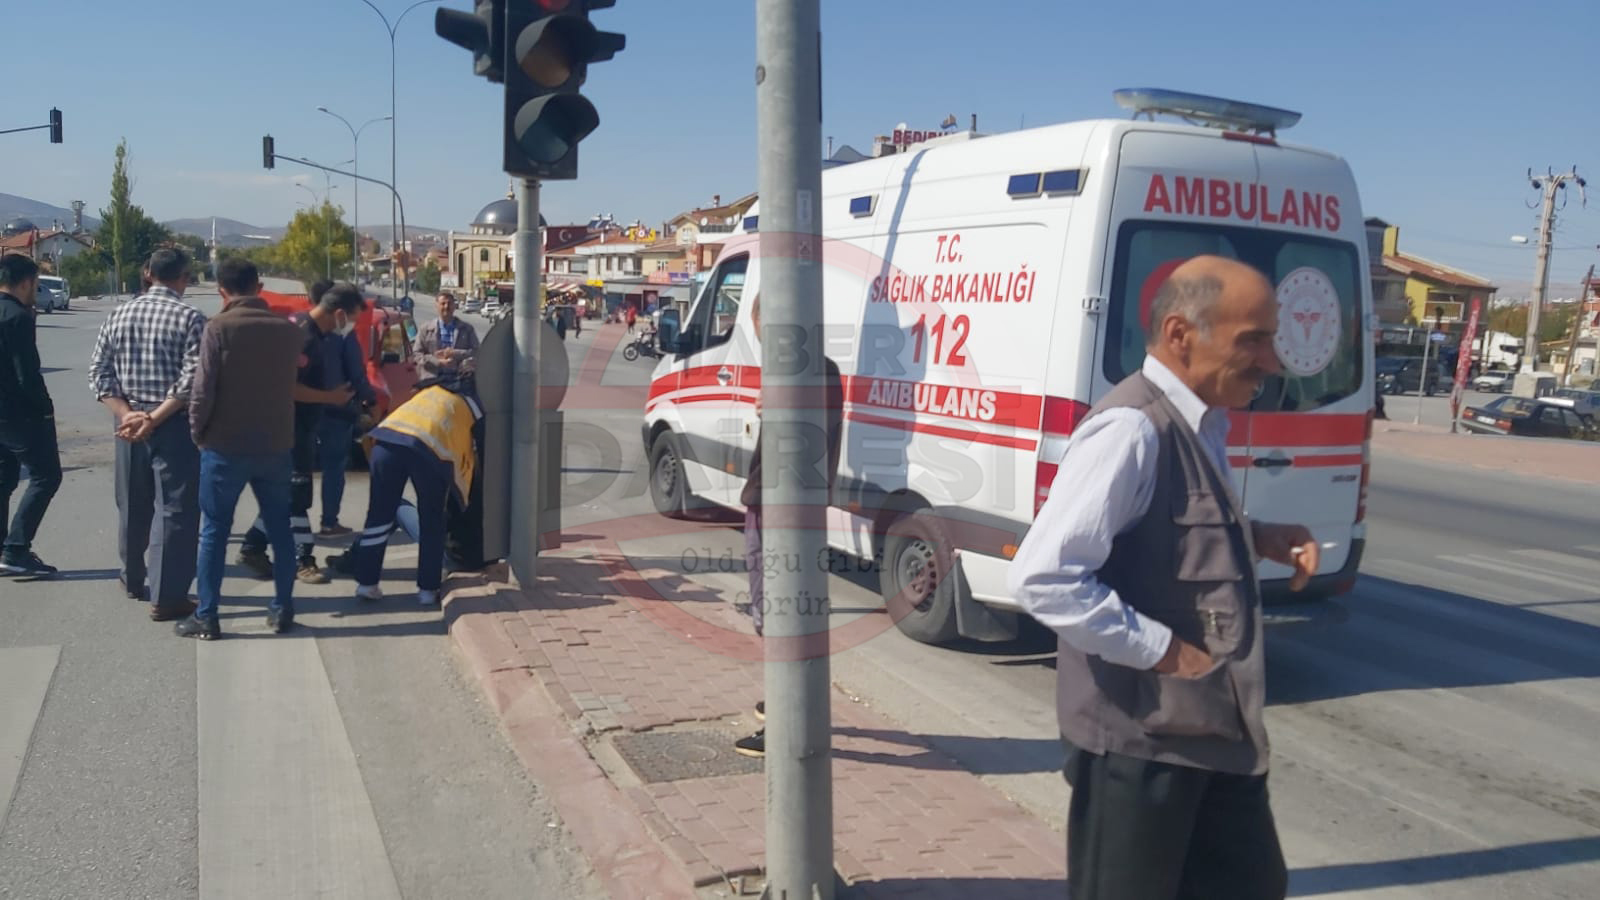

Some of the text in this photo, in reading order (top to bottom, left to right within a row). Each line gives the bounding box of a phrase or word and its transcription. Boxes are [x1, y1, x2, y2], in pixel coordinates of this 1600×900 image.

[1144, 174, 1341, 232] AMBULANS
[936, 234, 963, 263] T.C.
[871, 263, 1037, 304] SAĞLIK BAKANLIĞI
[910, 313, 971, 367] 112
[866, 379, 998, 421] AMBULANS
